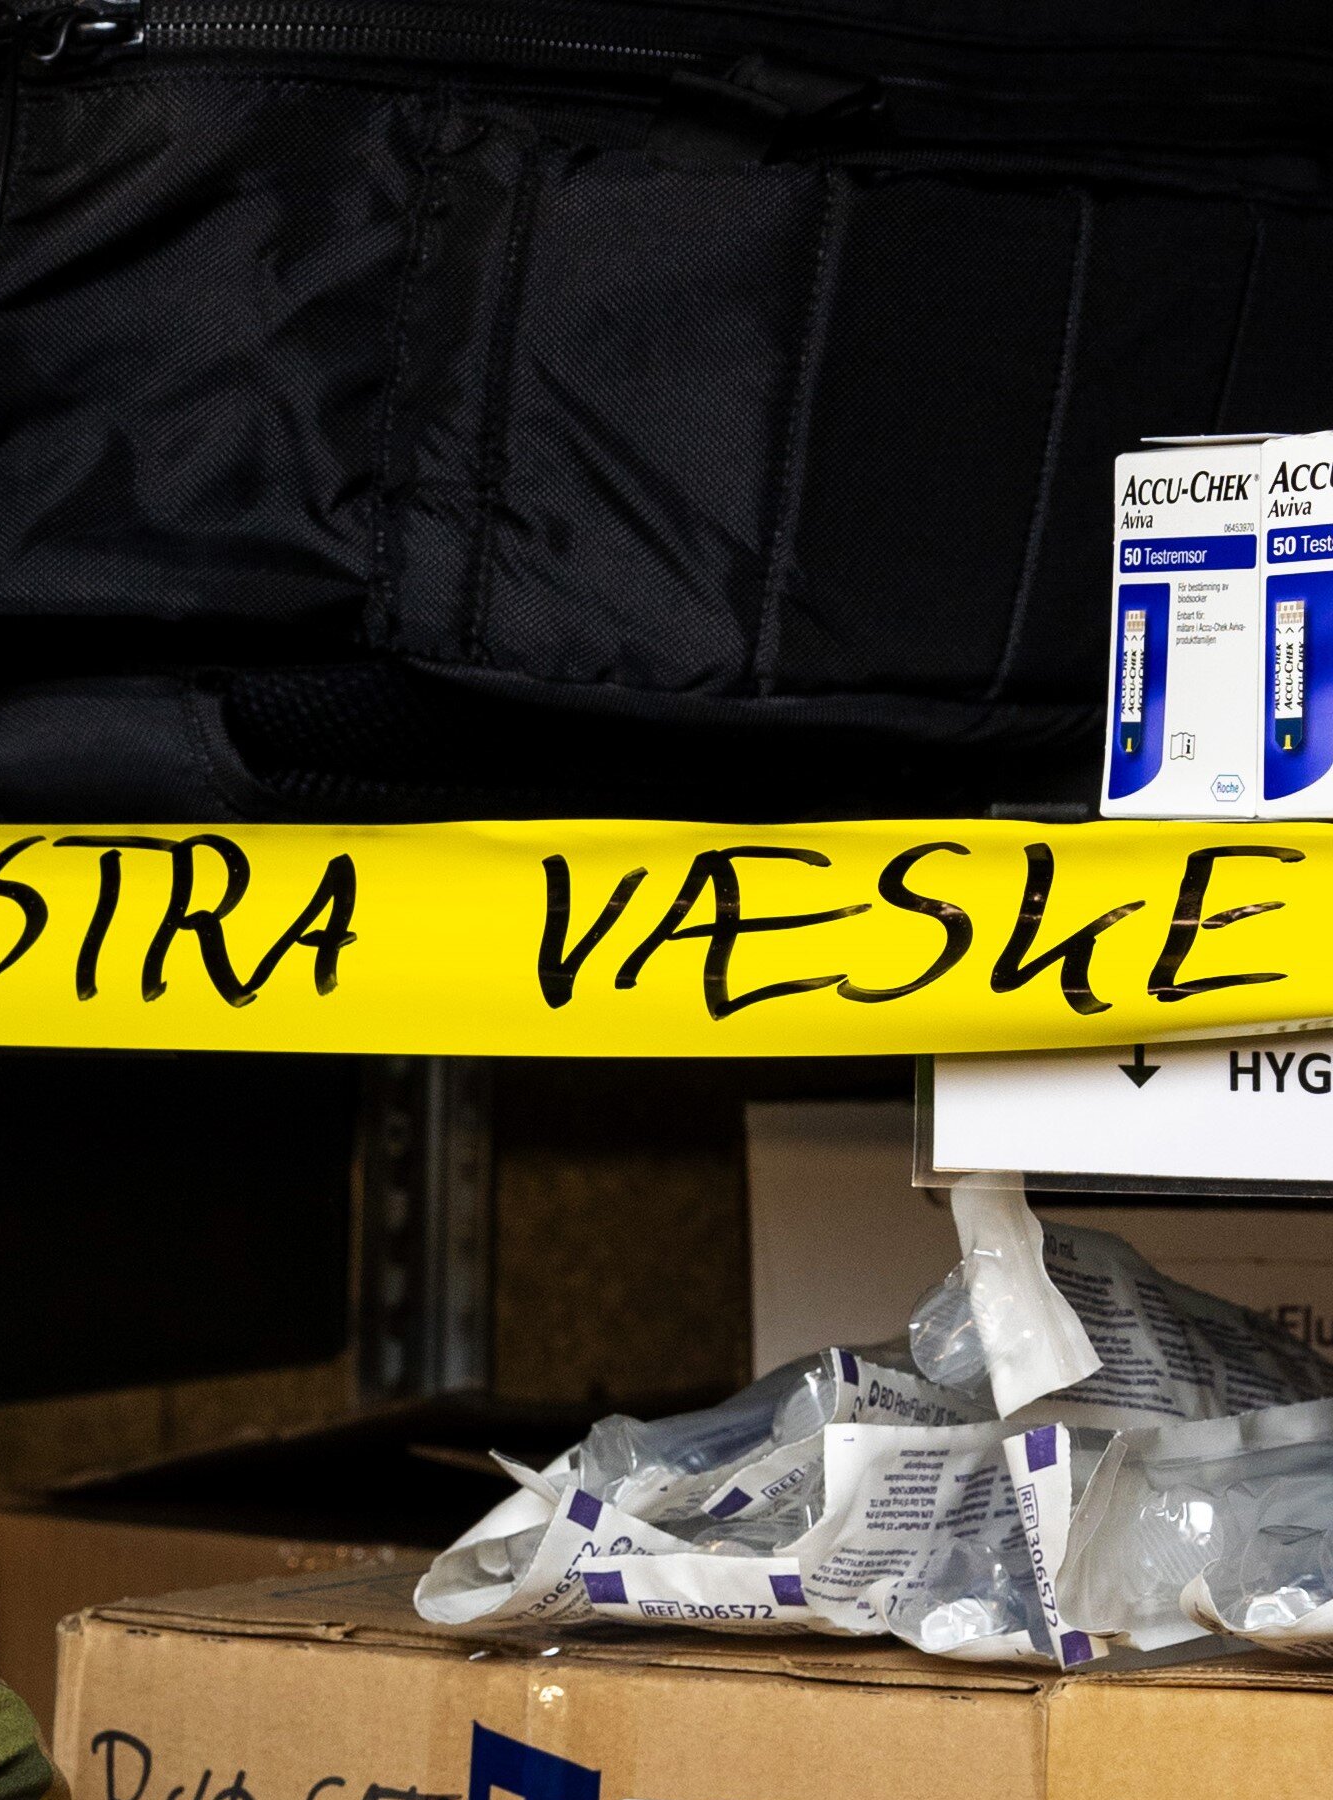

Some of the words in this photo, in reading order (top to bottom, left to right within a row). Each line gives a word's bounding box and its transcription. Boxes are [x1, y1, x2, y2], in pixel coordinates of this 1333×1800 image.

[1268, 461, 1333, 494] ACC
[1267, 497, 1312, 518] Aviva
[1121, 510, 1153, 529] Aviva
[1124, 547, 1142, 566] 50
[1145, 546, 1208, 566] Testremsor
[1273, 535, 1297, 556] 50
[1283, 642, 1295, 711] ACCU-CHEK
[1216, 781, 1240, 794] Roche
[537, 842, 1306, 1020] VÆSKE
[1230, 1050, 1332, 1094] HYG
[1019, 1488, 1037, 1524] REF
[644, 1604, 681, 1619] REF
[684, 1603, 776, 1621] 306572
